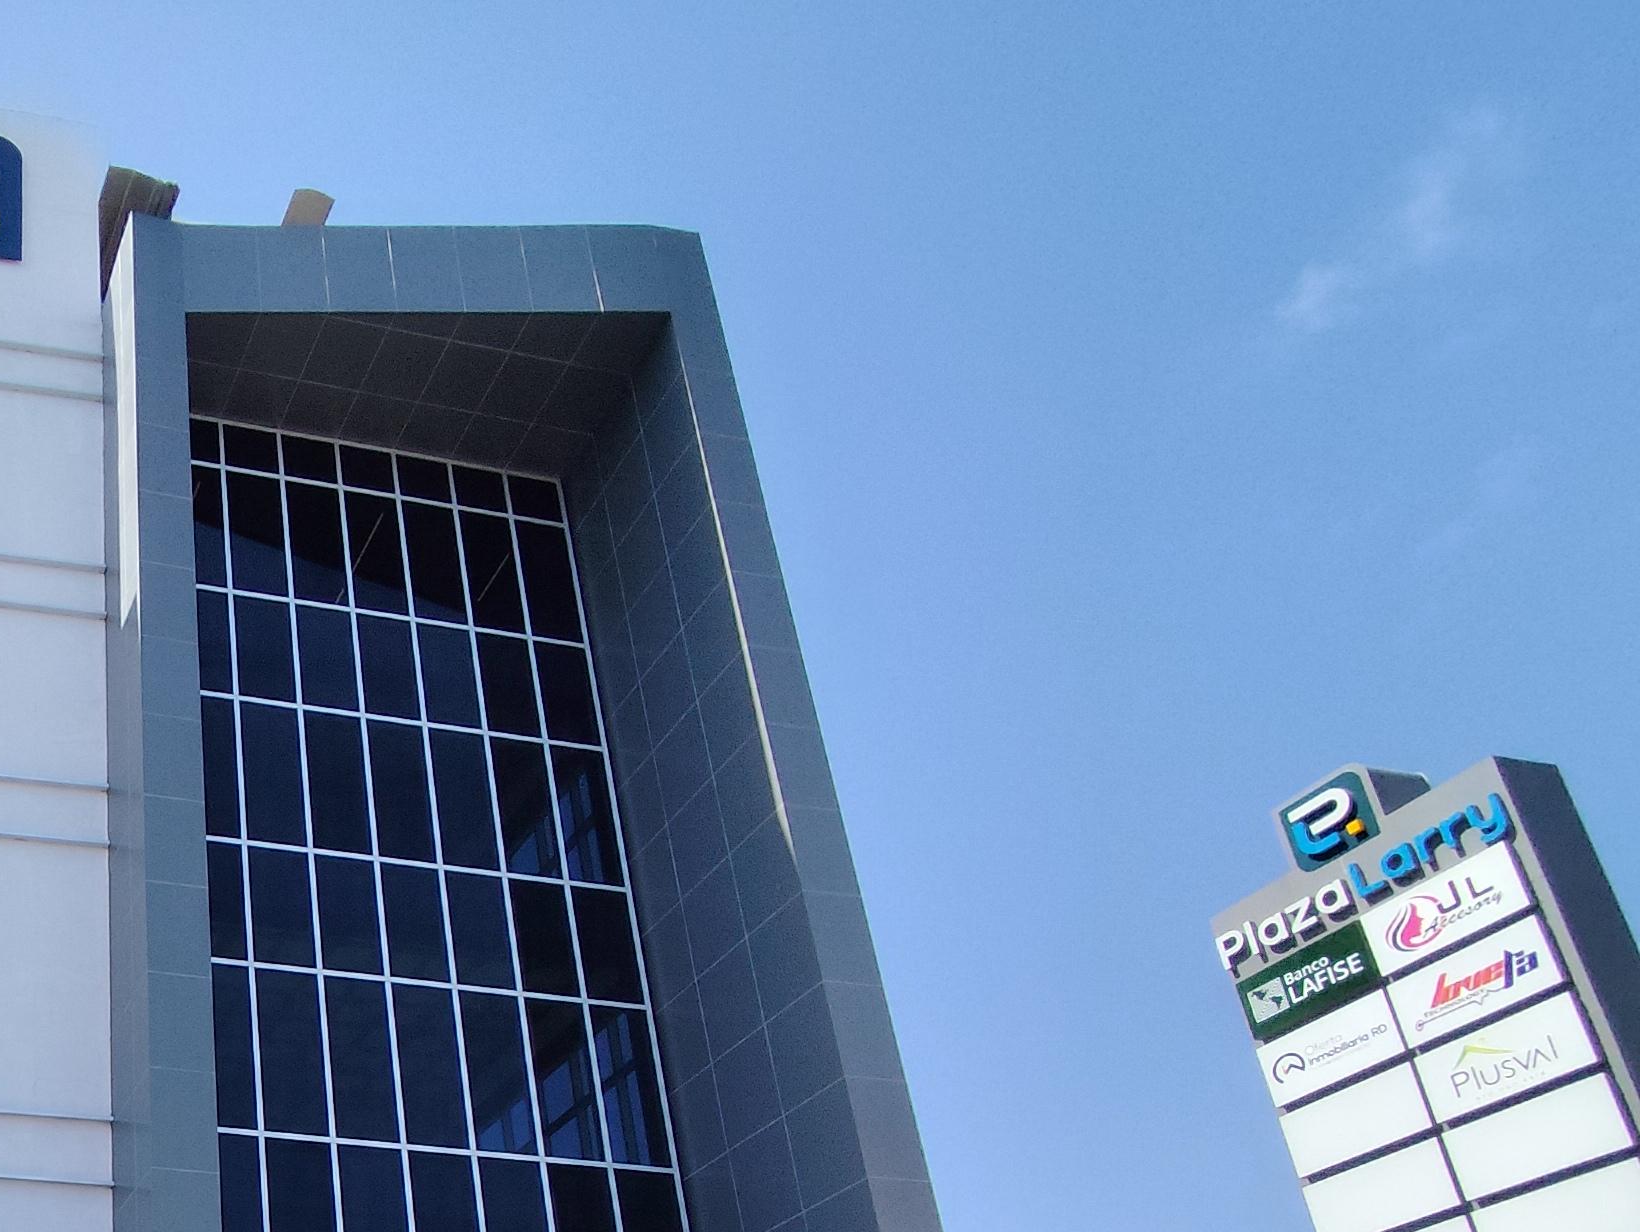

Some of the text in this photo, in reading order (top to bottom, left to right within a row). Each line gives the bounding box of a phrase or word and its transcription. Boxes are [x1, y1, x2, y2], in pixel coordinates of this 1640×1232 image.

[1215, 793, 1512, 971] Plaza Larry
[1283, 956, 1330, 985] Banco
[1287, 952, 1365, 1003] LAFISE
